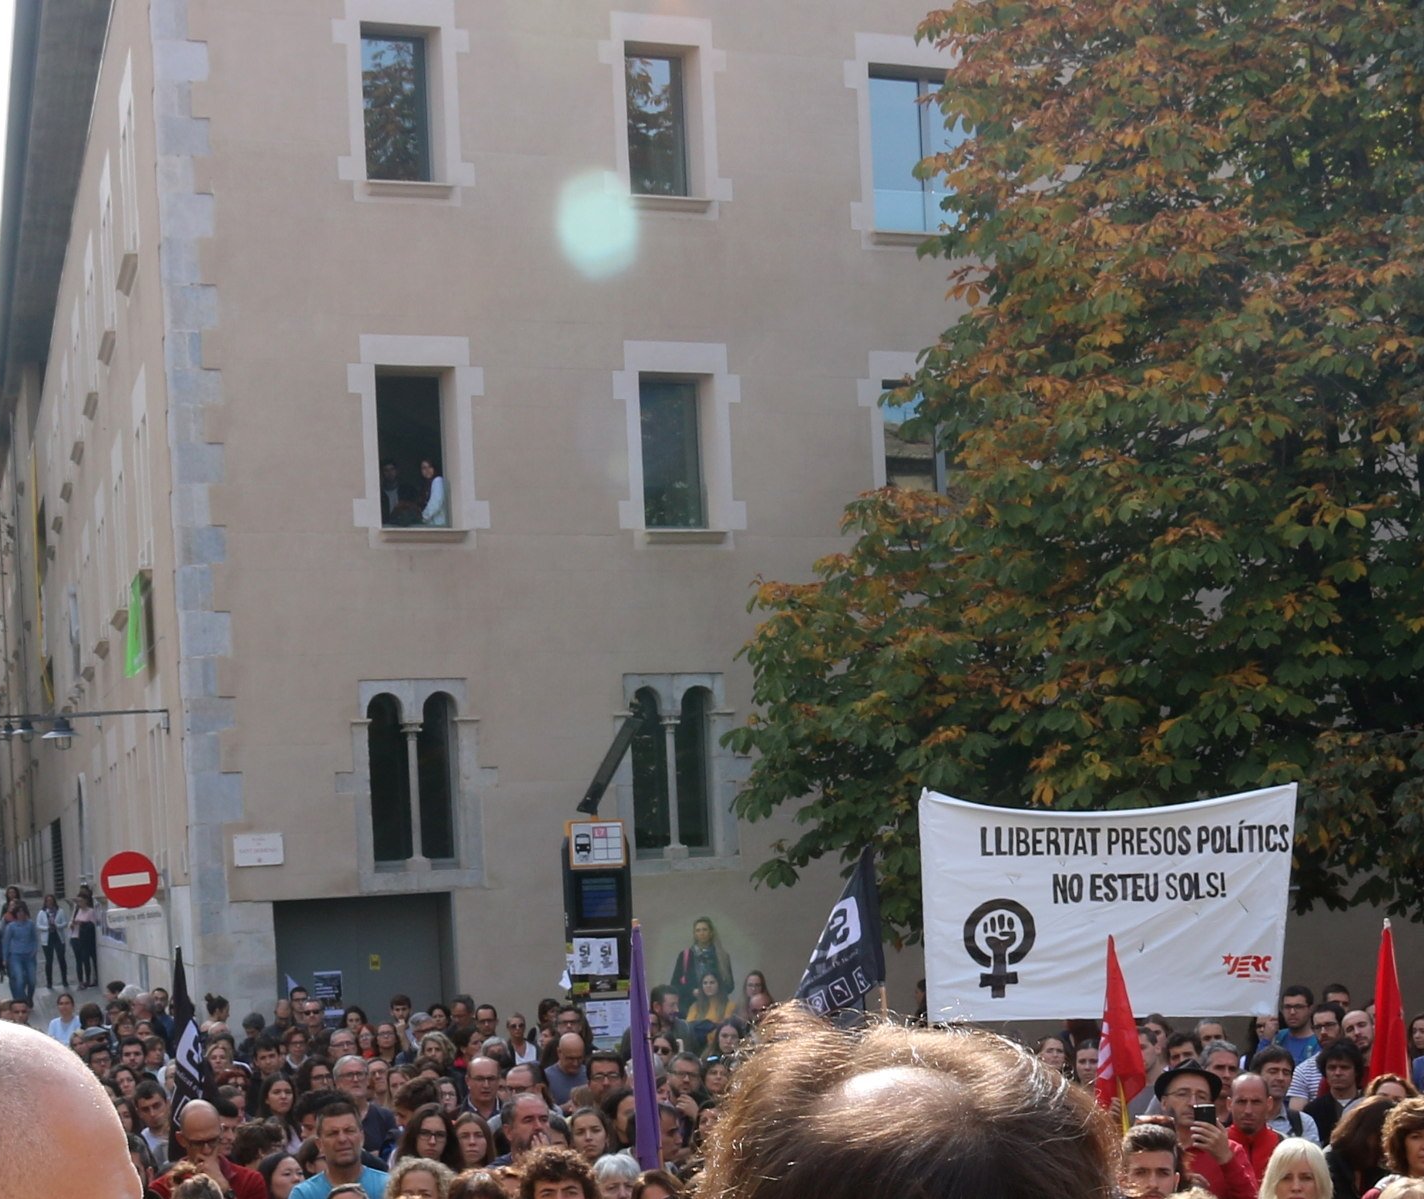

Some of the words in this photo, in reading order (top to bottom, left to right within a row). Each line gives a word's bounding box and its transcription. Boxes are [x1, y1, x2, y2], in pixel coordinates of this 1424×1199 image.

[980, 826, 1101, 857] LLIBERTAT
[1107, 824, 1191, 856] PRESOS
[1197, 819, 1290, 854] POLÍTICS
[1052, 873, 1083, 904] NO
[1090, 873, 1158, 903] ESTEU
[1165, 871, 1227, 900] SOLS!
